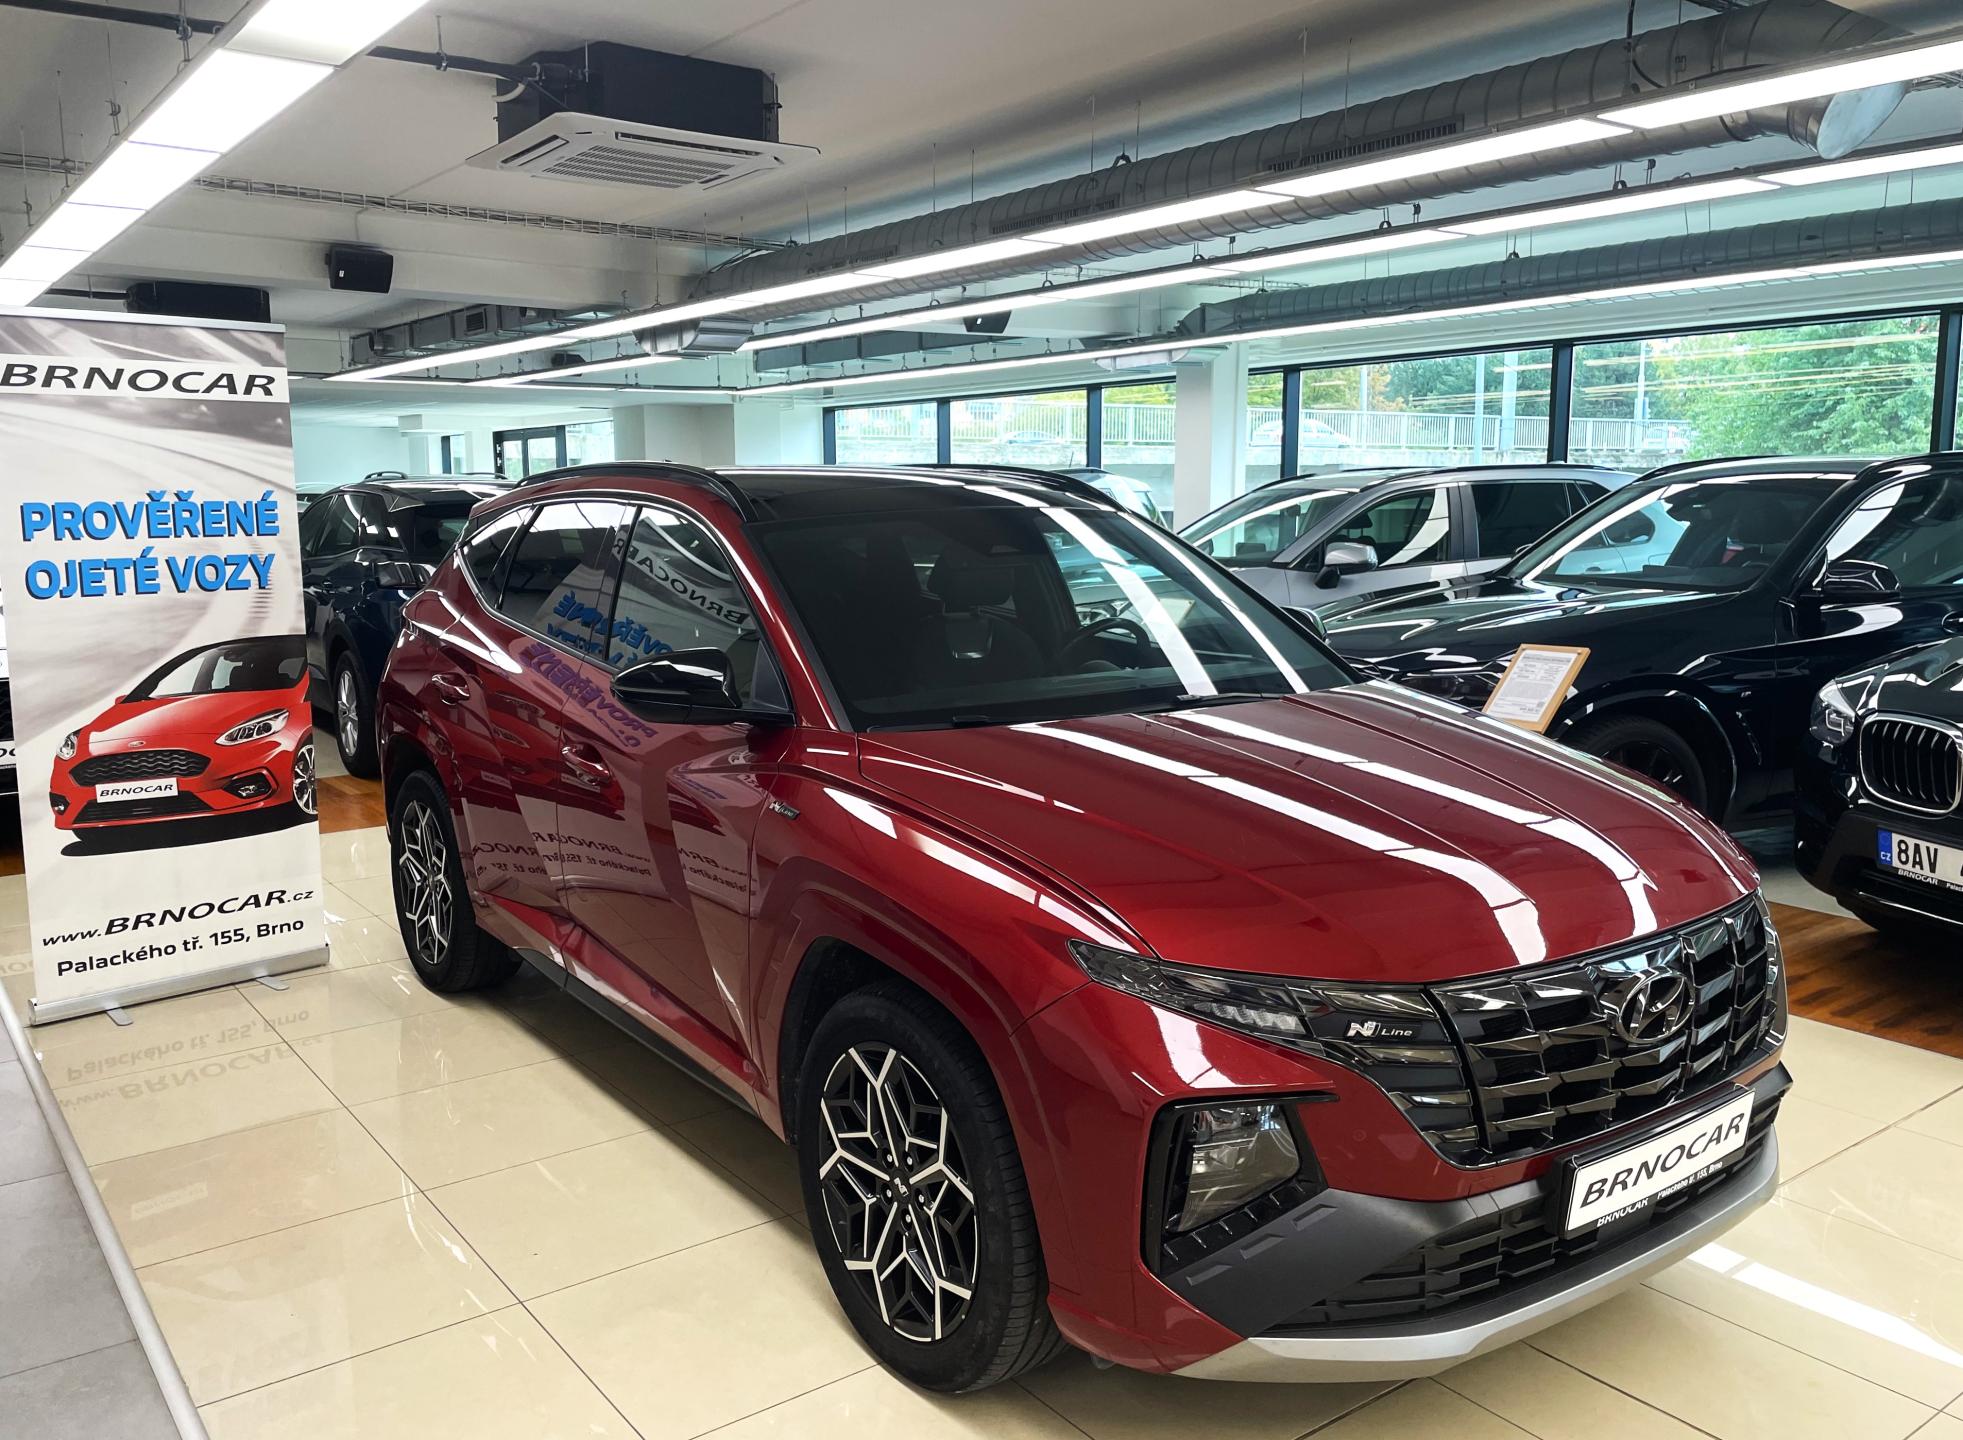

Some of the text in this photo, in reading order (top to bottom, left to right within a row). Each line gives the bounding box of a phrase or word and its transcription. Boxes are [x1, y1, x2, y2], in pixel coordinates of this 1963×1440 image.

[0, 363, 276, 397] BRNOCAR
[20, 490, 280, 541] PROVĚŘENÉ
[25, 546, 275, 600] OJETÉ VOZY
[100, 784, 174, 797] BRNOCAR
[1880, 851, 1891, 861] CZ
[1897, 839, 1939, 875] 8AV
[1898, 868, 1939, 886] BRNOCAR
[42, 889, 314, 946] www.BRNOCAR.cz
[57, 919, 304, 977] Palackého tř. 155, Brno
[1381, 1028, 1413, 1036] Line
[1579, 1112, 1745, 1209] BRNOCAR
